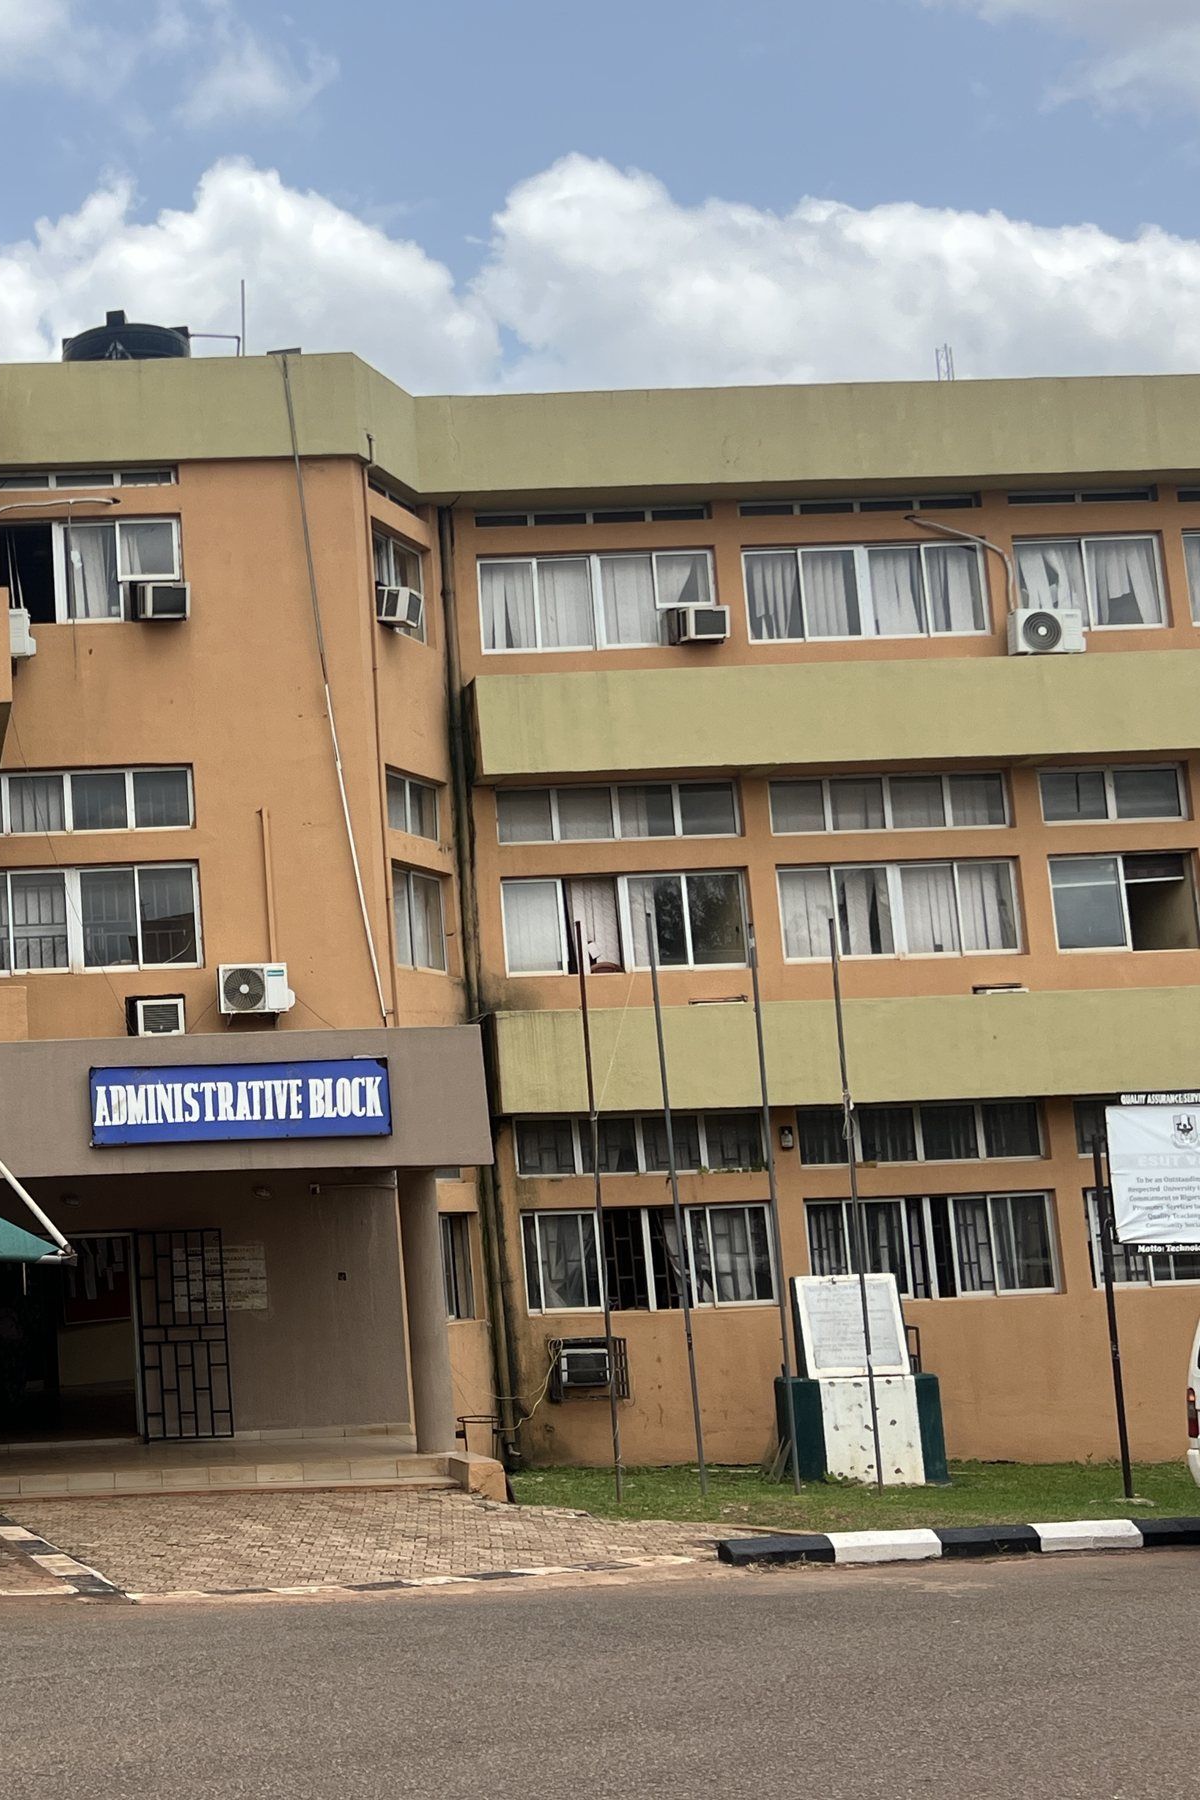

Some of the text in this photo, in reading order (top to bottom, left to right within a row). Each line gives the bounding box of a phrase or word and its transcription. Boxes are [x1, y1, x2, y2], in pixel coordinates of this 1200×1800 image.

[93, 1076, 384, 1126] ADMINISTRATIVE BLOCK
[1120, 1093, 1146, 1105] QUALITY
[1147, 1093, 1183, 1104] ASSURANCE
